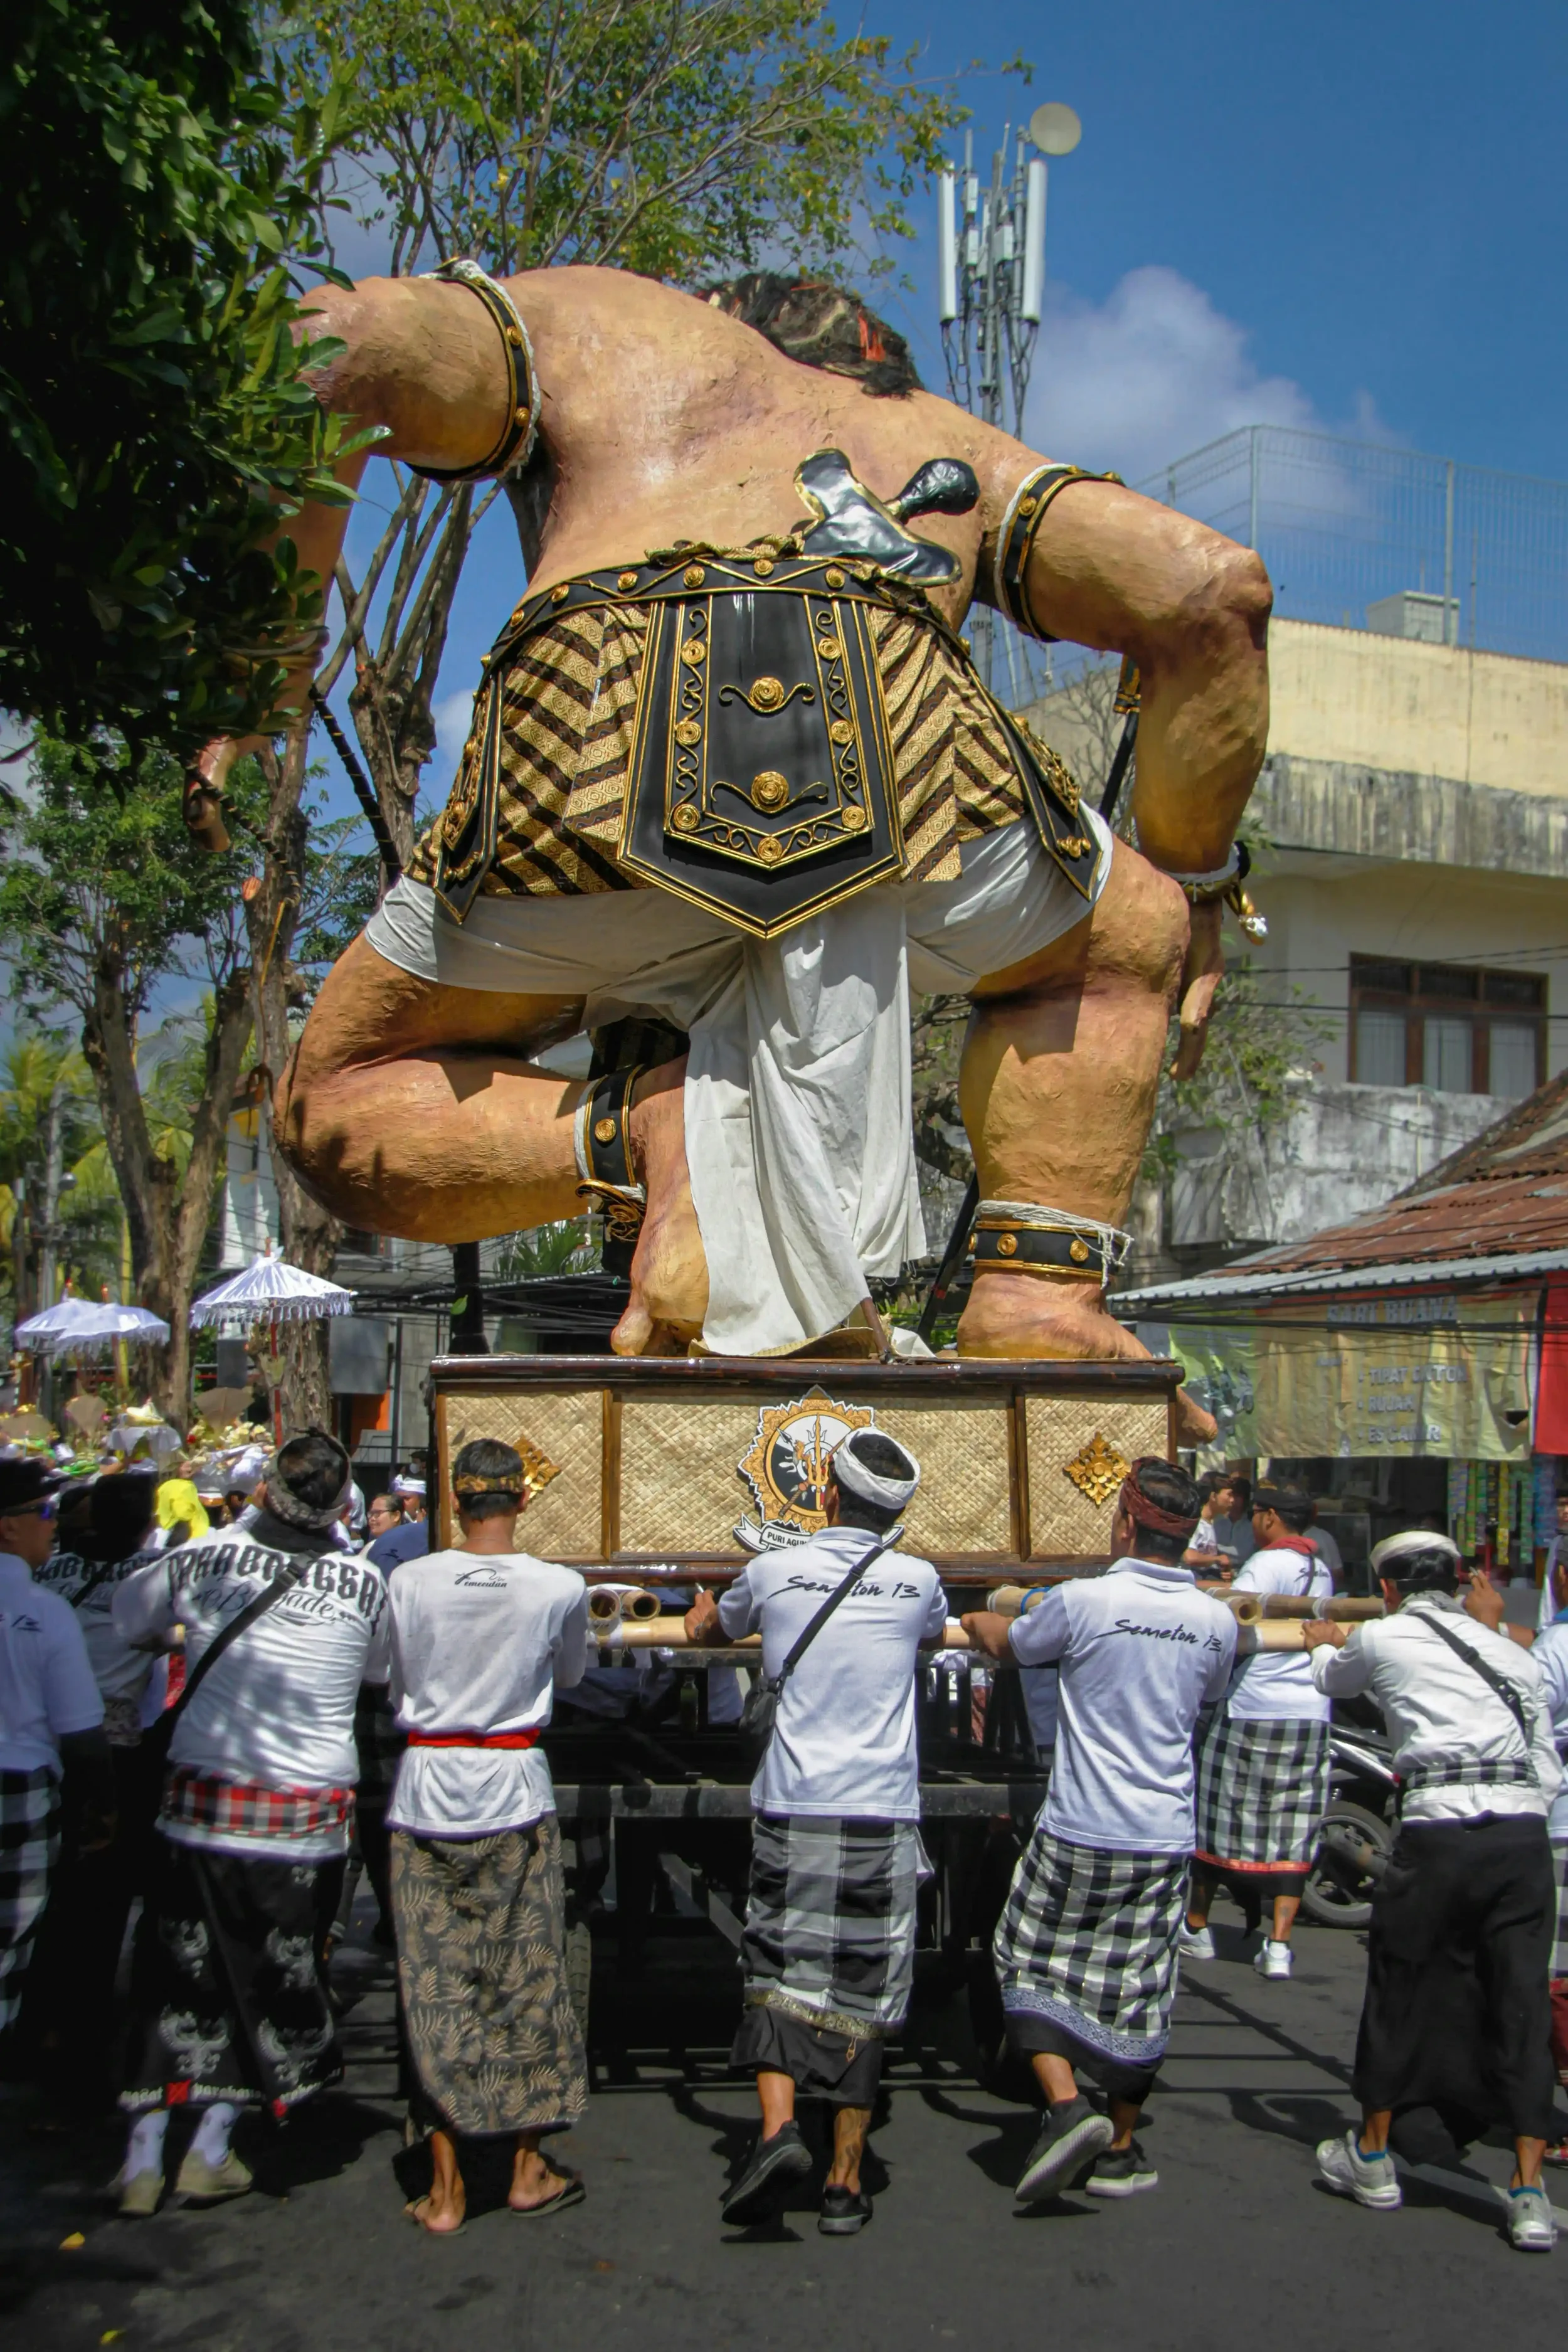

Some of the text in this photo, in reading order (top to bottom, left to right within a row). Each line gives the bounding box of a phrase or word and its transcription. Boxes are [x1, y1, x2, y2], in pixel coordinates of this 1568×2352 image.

[1369, 1366, 1408, 1385] TIPAT
[1369, 1425, 1384, 1443] ES
[767, 1532, 807, 1547] PURI AGUN
[767, 1576, 921, 1599] Semton 13
[1090, 1619, 1222, 1652] Semeton 13
